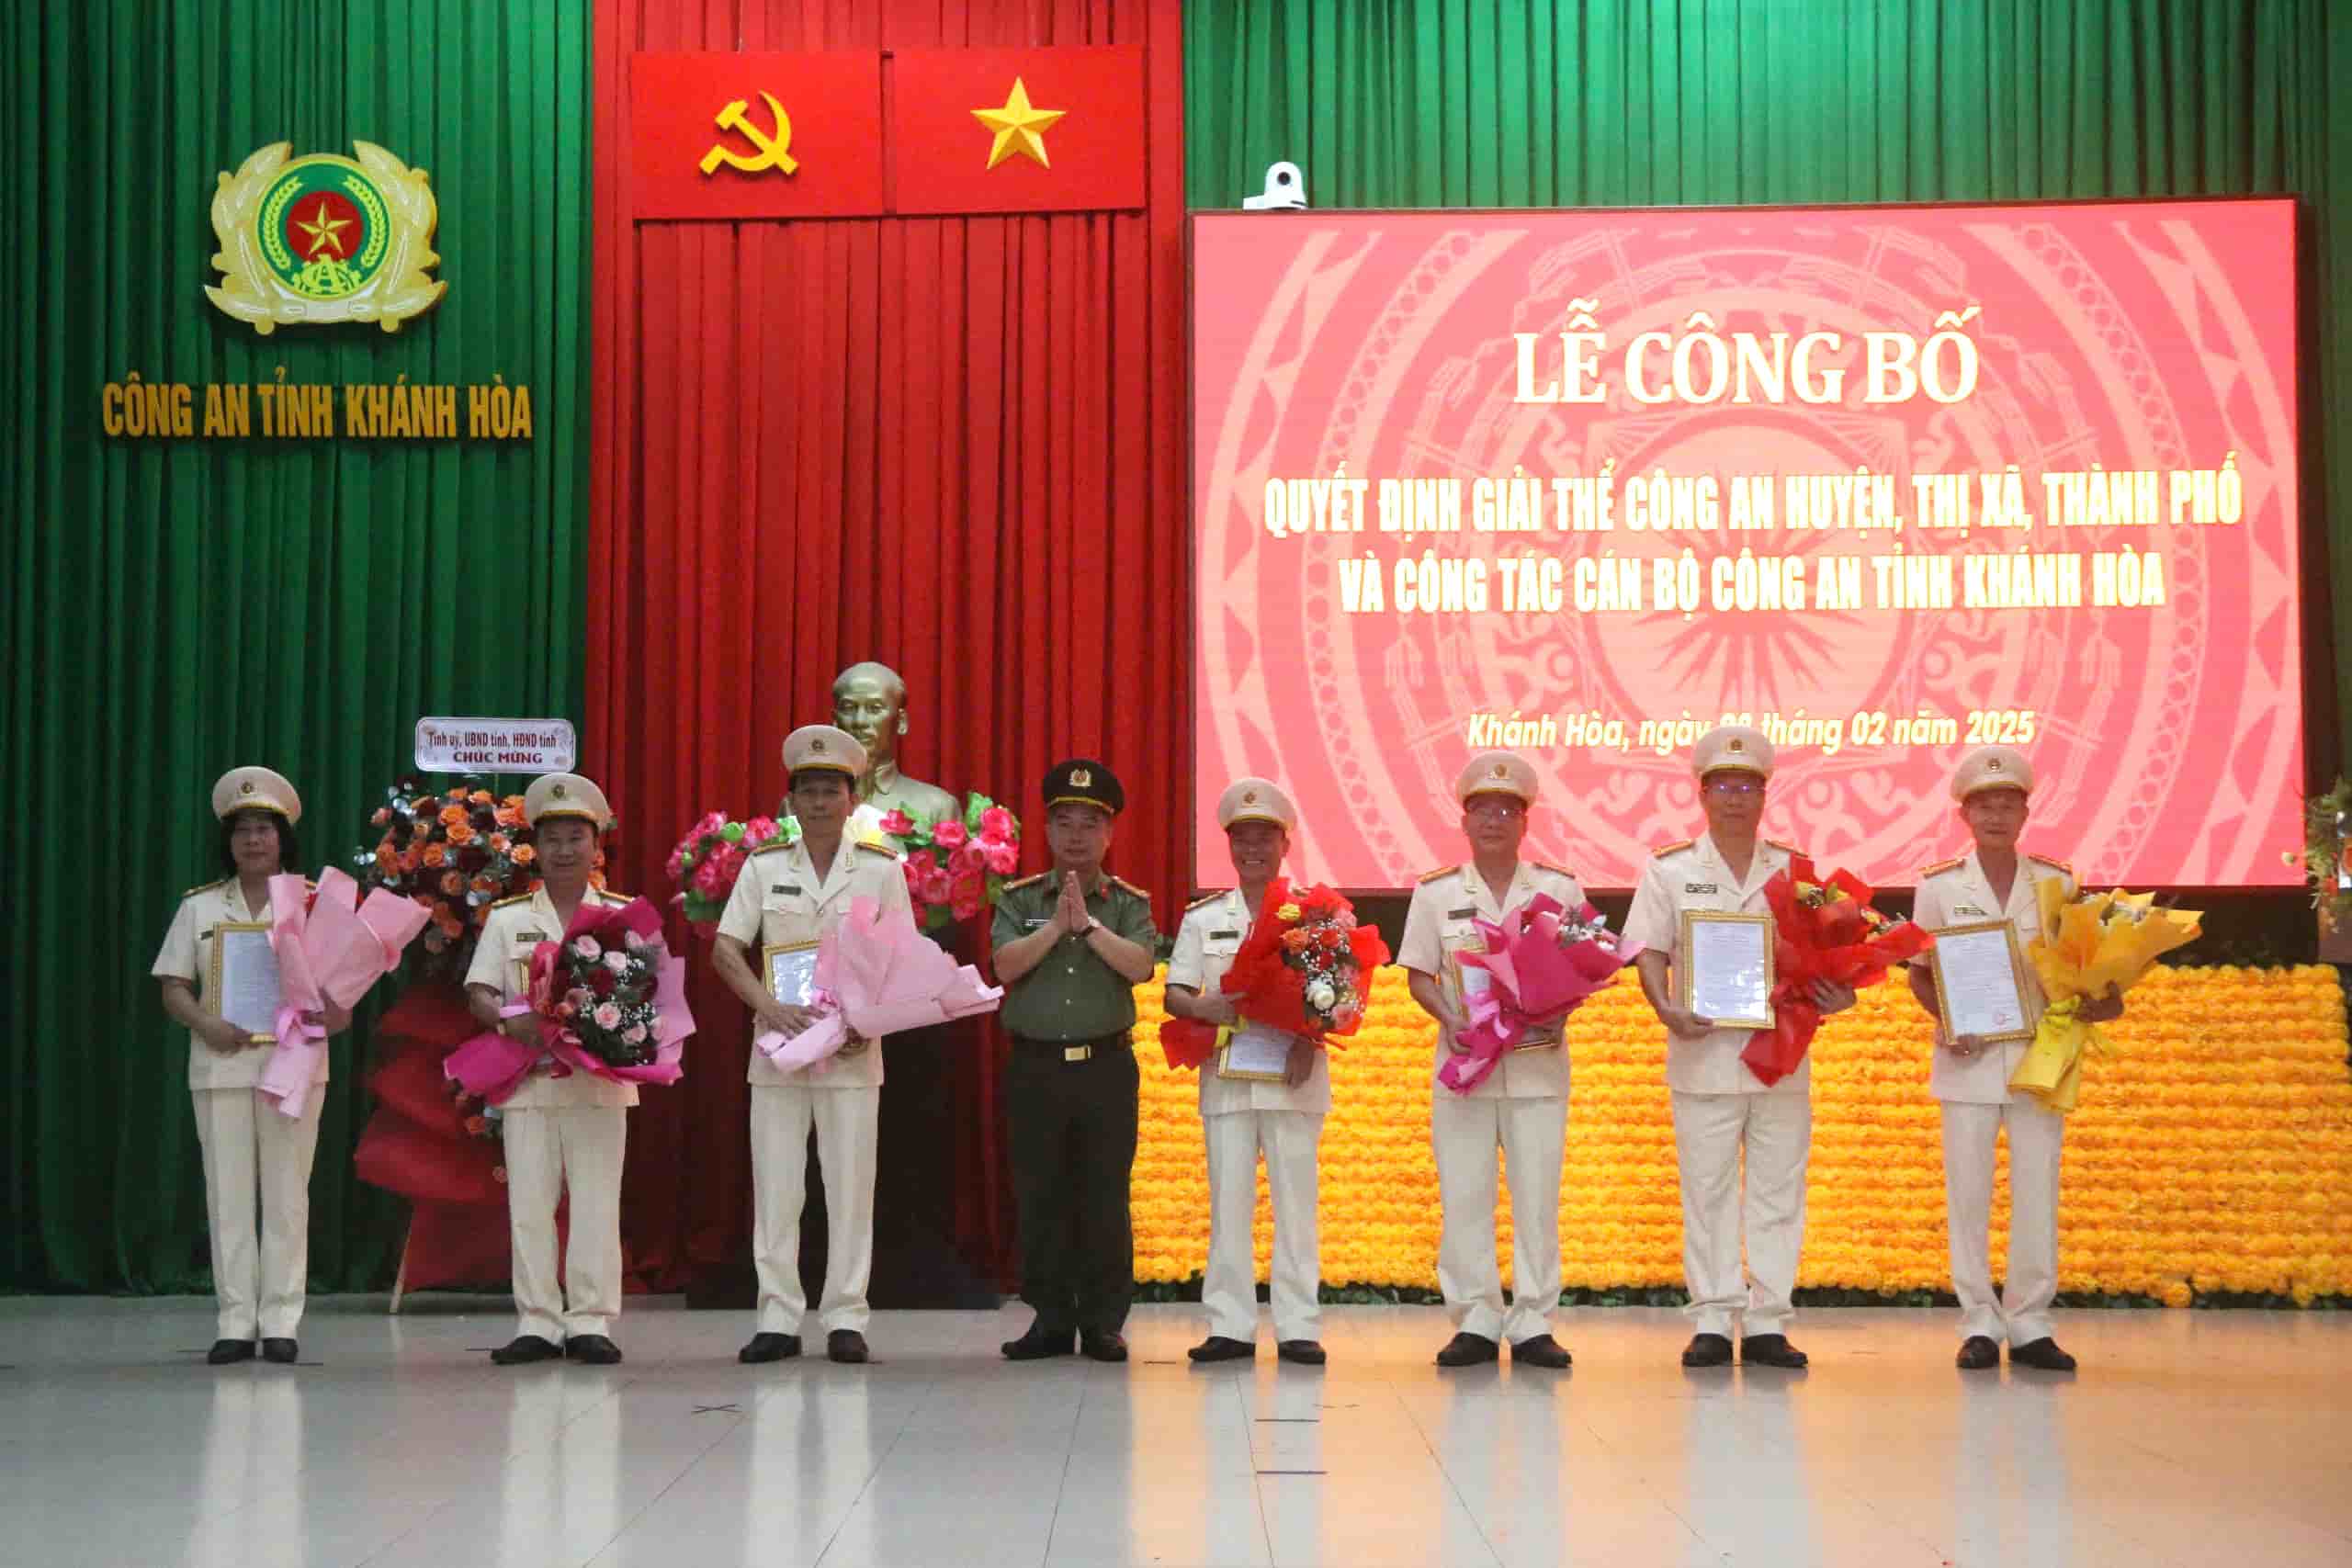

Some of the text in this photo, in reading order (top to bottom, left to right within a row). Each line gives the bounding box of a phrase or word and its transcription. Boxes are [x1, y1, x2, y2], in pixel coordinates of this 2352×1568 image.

[1513, 298, 1983, 404] LỄ CÔNG BỐ
[102, 366, 532, 439] CÔNG AN TỈNH KHÁNH HÒA
[1264, 450, 2244, 542] QUYẾT ĐỊNH GIẢI THỂ CÔNG AN HUYỆN, THỊ XÃ, THÀNH PHỐ
[1338, 541, 2165, 622] VÀ CÔNG TÁC CÁN BỘ CÔNG AN TỈNH KHÁNH HÒA
[1467, 711, 1557, 748] Khánh
[1564, 711, 1631, 753] Hòa,
[1760, 709, 1844, 757] tháng
[1850, 710, 1889, 746] 02
[1893, 709, 1959, 746] năm
[1964, 709, 2036, 745] 2025
